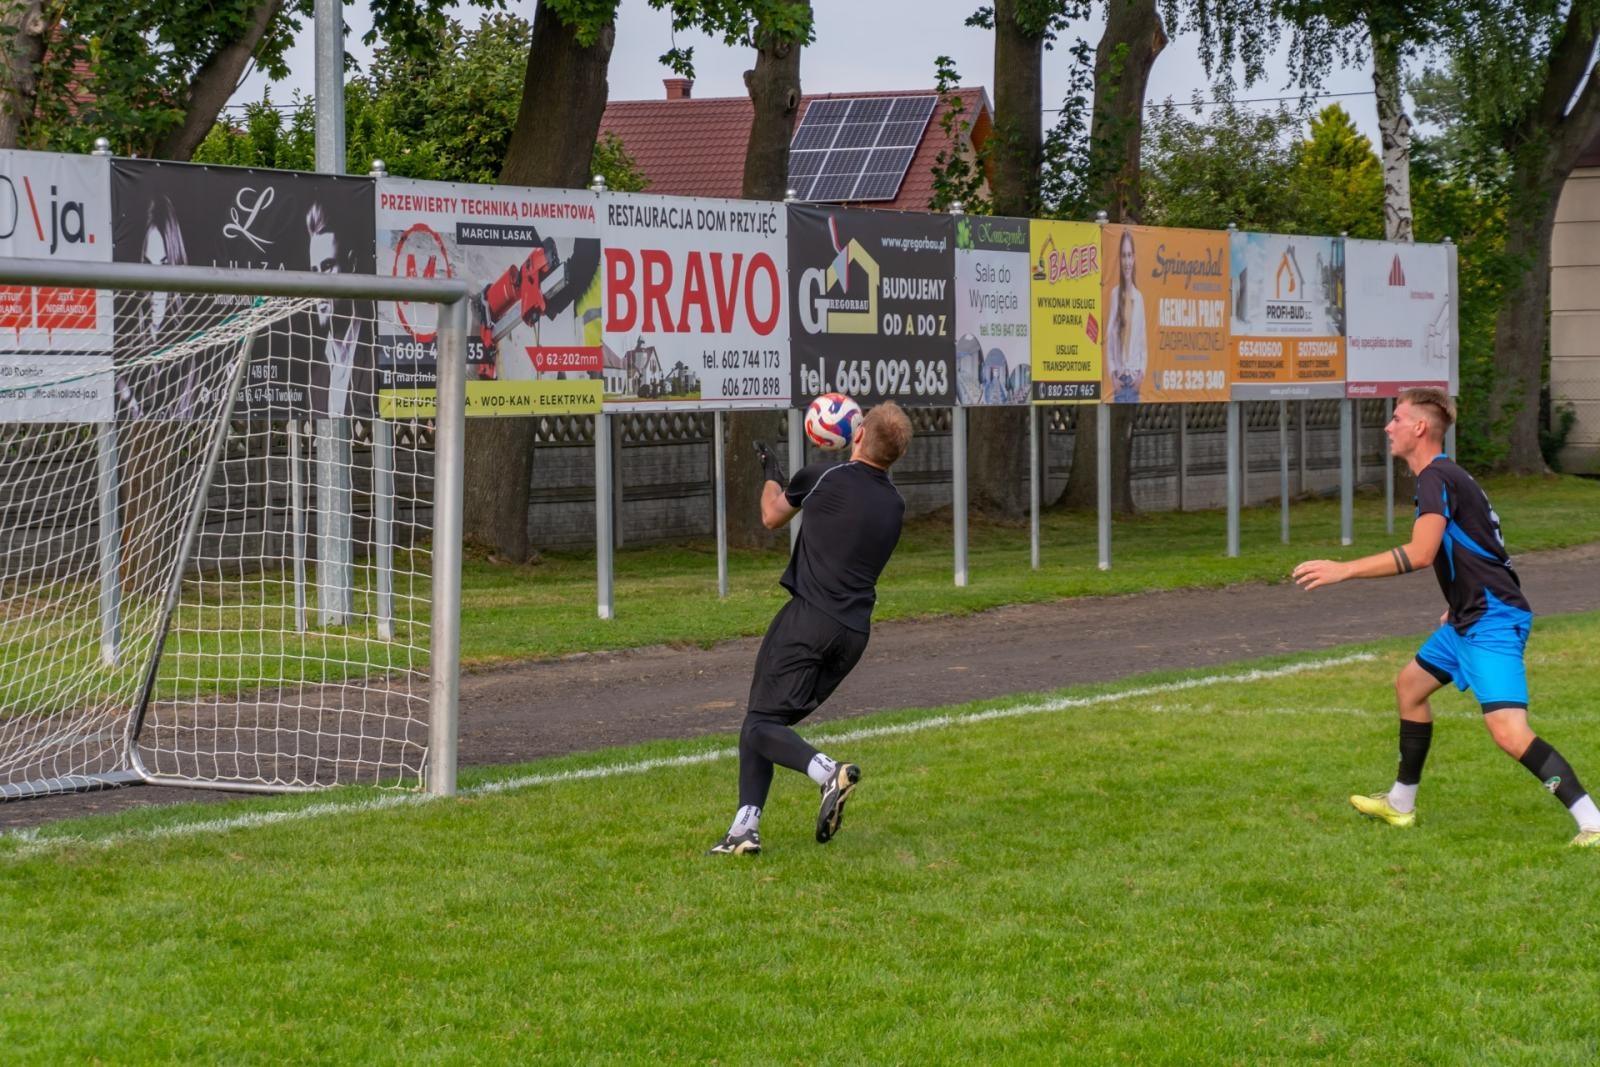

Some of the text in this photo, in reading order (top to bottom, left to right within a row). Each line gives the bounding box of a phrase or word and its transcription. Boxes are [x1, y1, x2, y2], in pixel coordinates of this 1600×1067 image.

[381, 194, 596, 223] PRZEWIERTY TECHNIKĄ DIAMENTOWĄ
[608, 204, 777, 238] RESTAURACJA DOM PRZYJĘĆ
[462, 228, 533, 242] MARCIN LASAK
[881, 236, 948, 253] www.gregorbau.pl
[976, 263, 1011, 283] Sala do
[1048, 244, 1100, 285] BAGER
[604, 248, 781, 336] BRAVO
[882, 277, 947, 301] BUDUJEMY
[969, 288, 1018, 314] Wynajęcia
[1037, 296, 1096, 310] WYKONAM USŁUGI
[1052, 314, 1083, 328] KOPARKĄ
[1159, 298, 1225, 328] AGENCJA PRACY
[1266, 305, 1304, 320] PROFI-BUD
[883, 313, 946, 336] OD A DO Z
[991, 324, 1002, 337] 519
[1004, 324, 1015, 337] 847
[1016, 324, 1028, 337] 833
[396, 342, 424, 360] 608
[1056, 344, 1078, 356] USŁUGI
[1160, 331, 1225, 352] ZAGRANICZNEJ
[703, 350, 780, 370] tel. 602 744 173
[1043, 360, 1091, 372] TRANSPORTOWE
[800, 357, 948, 396] tel. 665 092 363
[1163, 370, 1225, 390] 692 329 340
[722, 378, 780, 396] 606 270 898
[1048, 384, 1096, 397] 880 557 965
[481, 396, 531, 407] WOD-KAN
[540, 394, 596, 406] ELEKTRYKA
